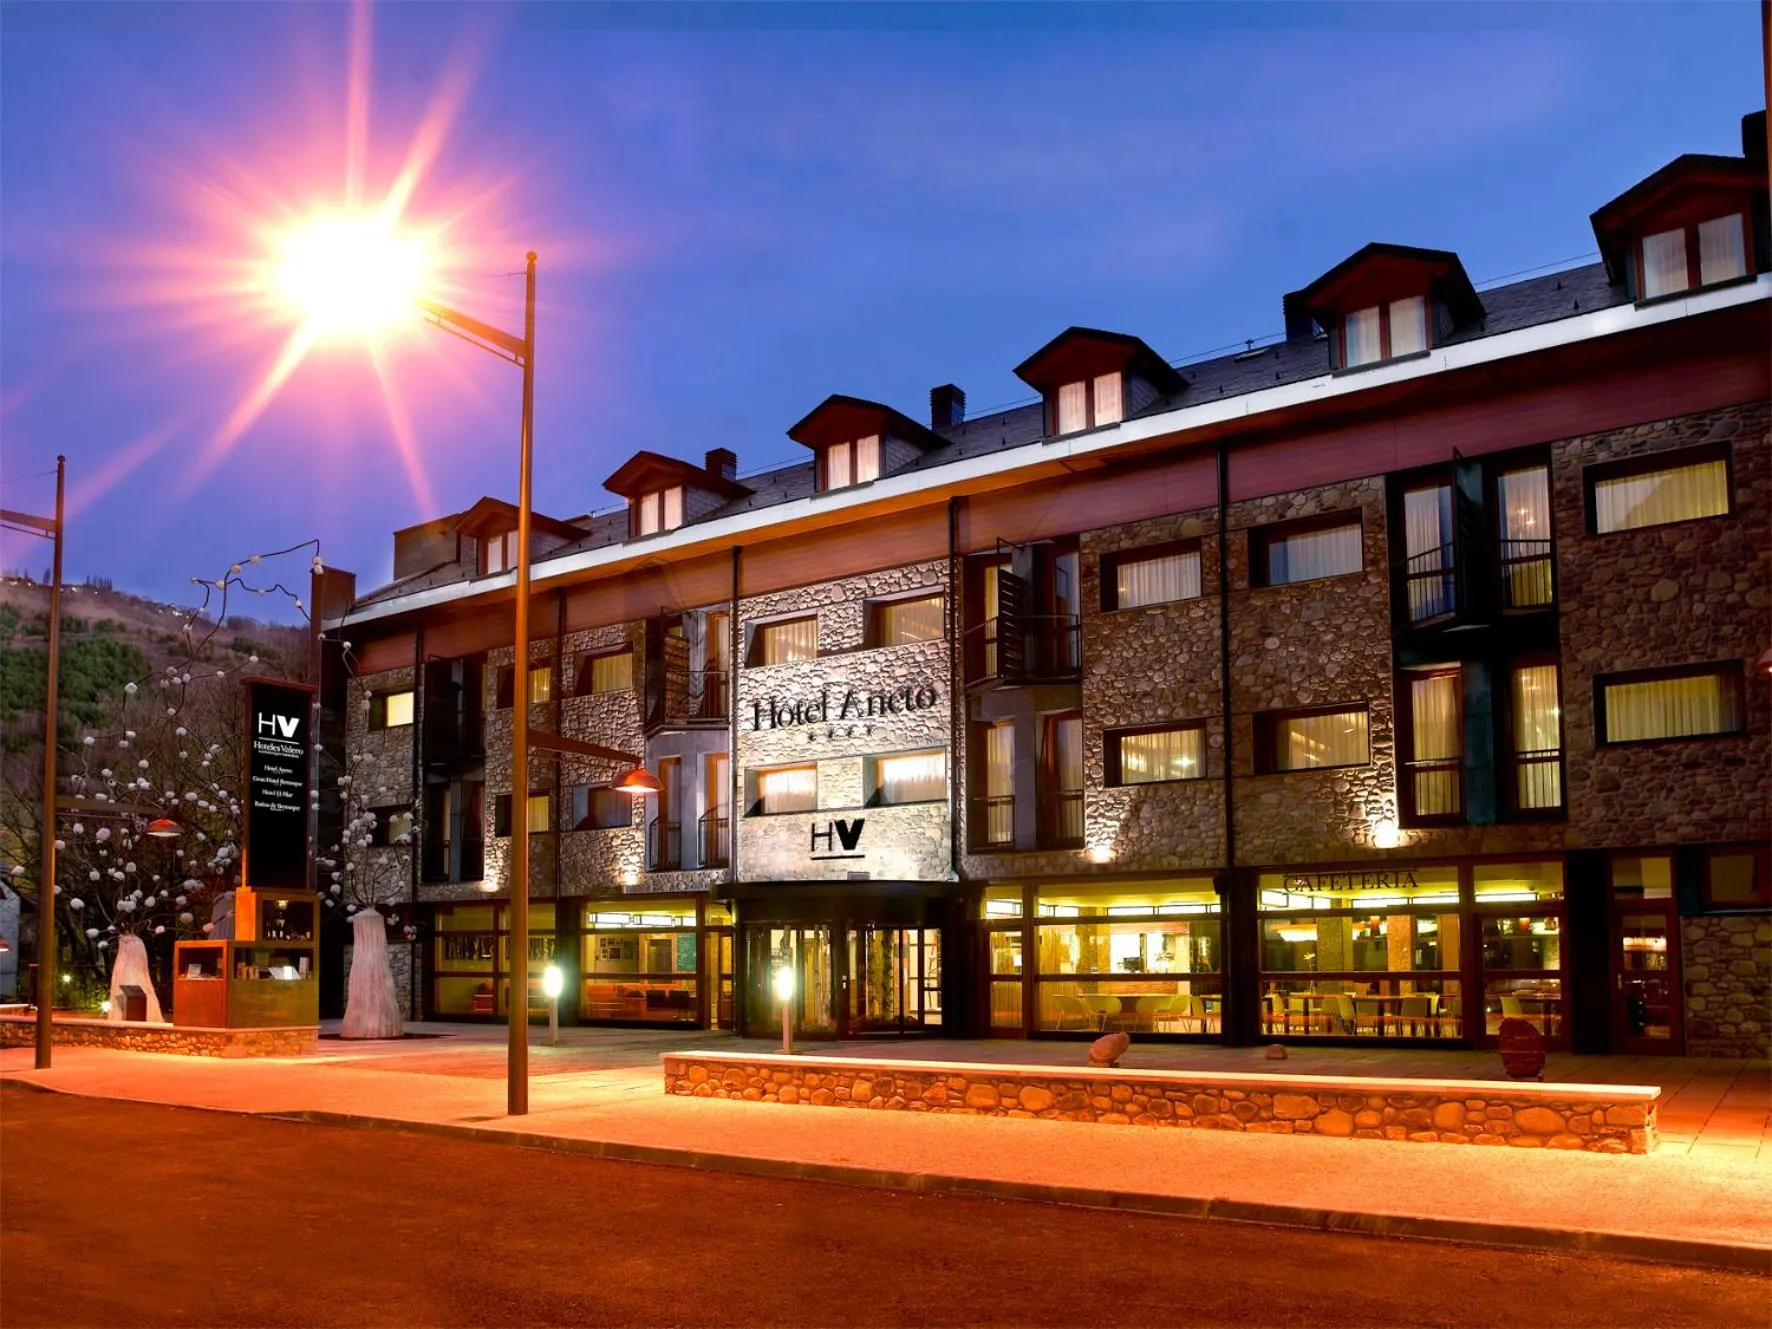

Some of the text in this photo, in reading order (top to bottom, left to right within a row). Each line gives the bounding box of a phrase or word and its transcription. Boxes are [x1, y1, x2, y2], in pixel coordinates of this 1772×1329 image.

[753, 686, 937, 731] Hotel Aneto
[258, 712, 300, 738] HV
[253, 740, 281, 752] Hoteles
[281, 744, 304, 756] Valero
[811, 818, 866, 852] HV
